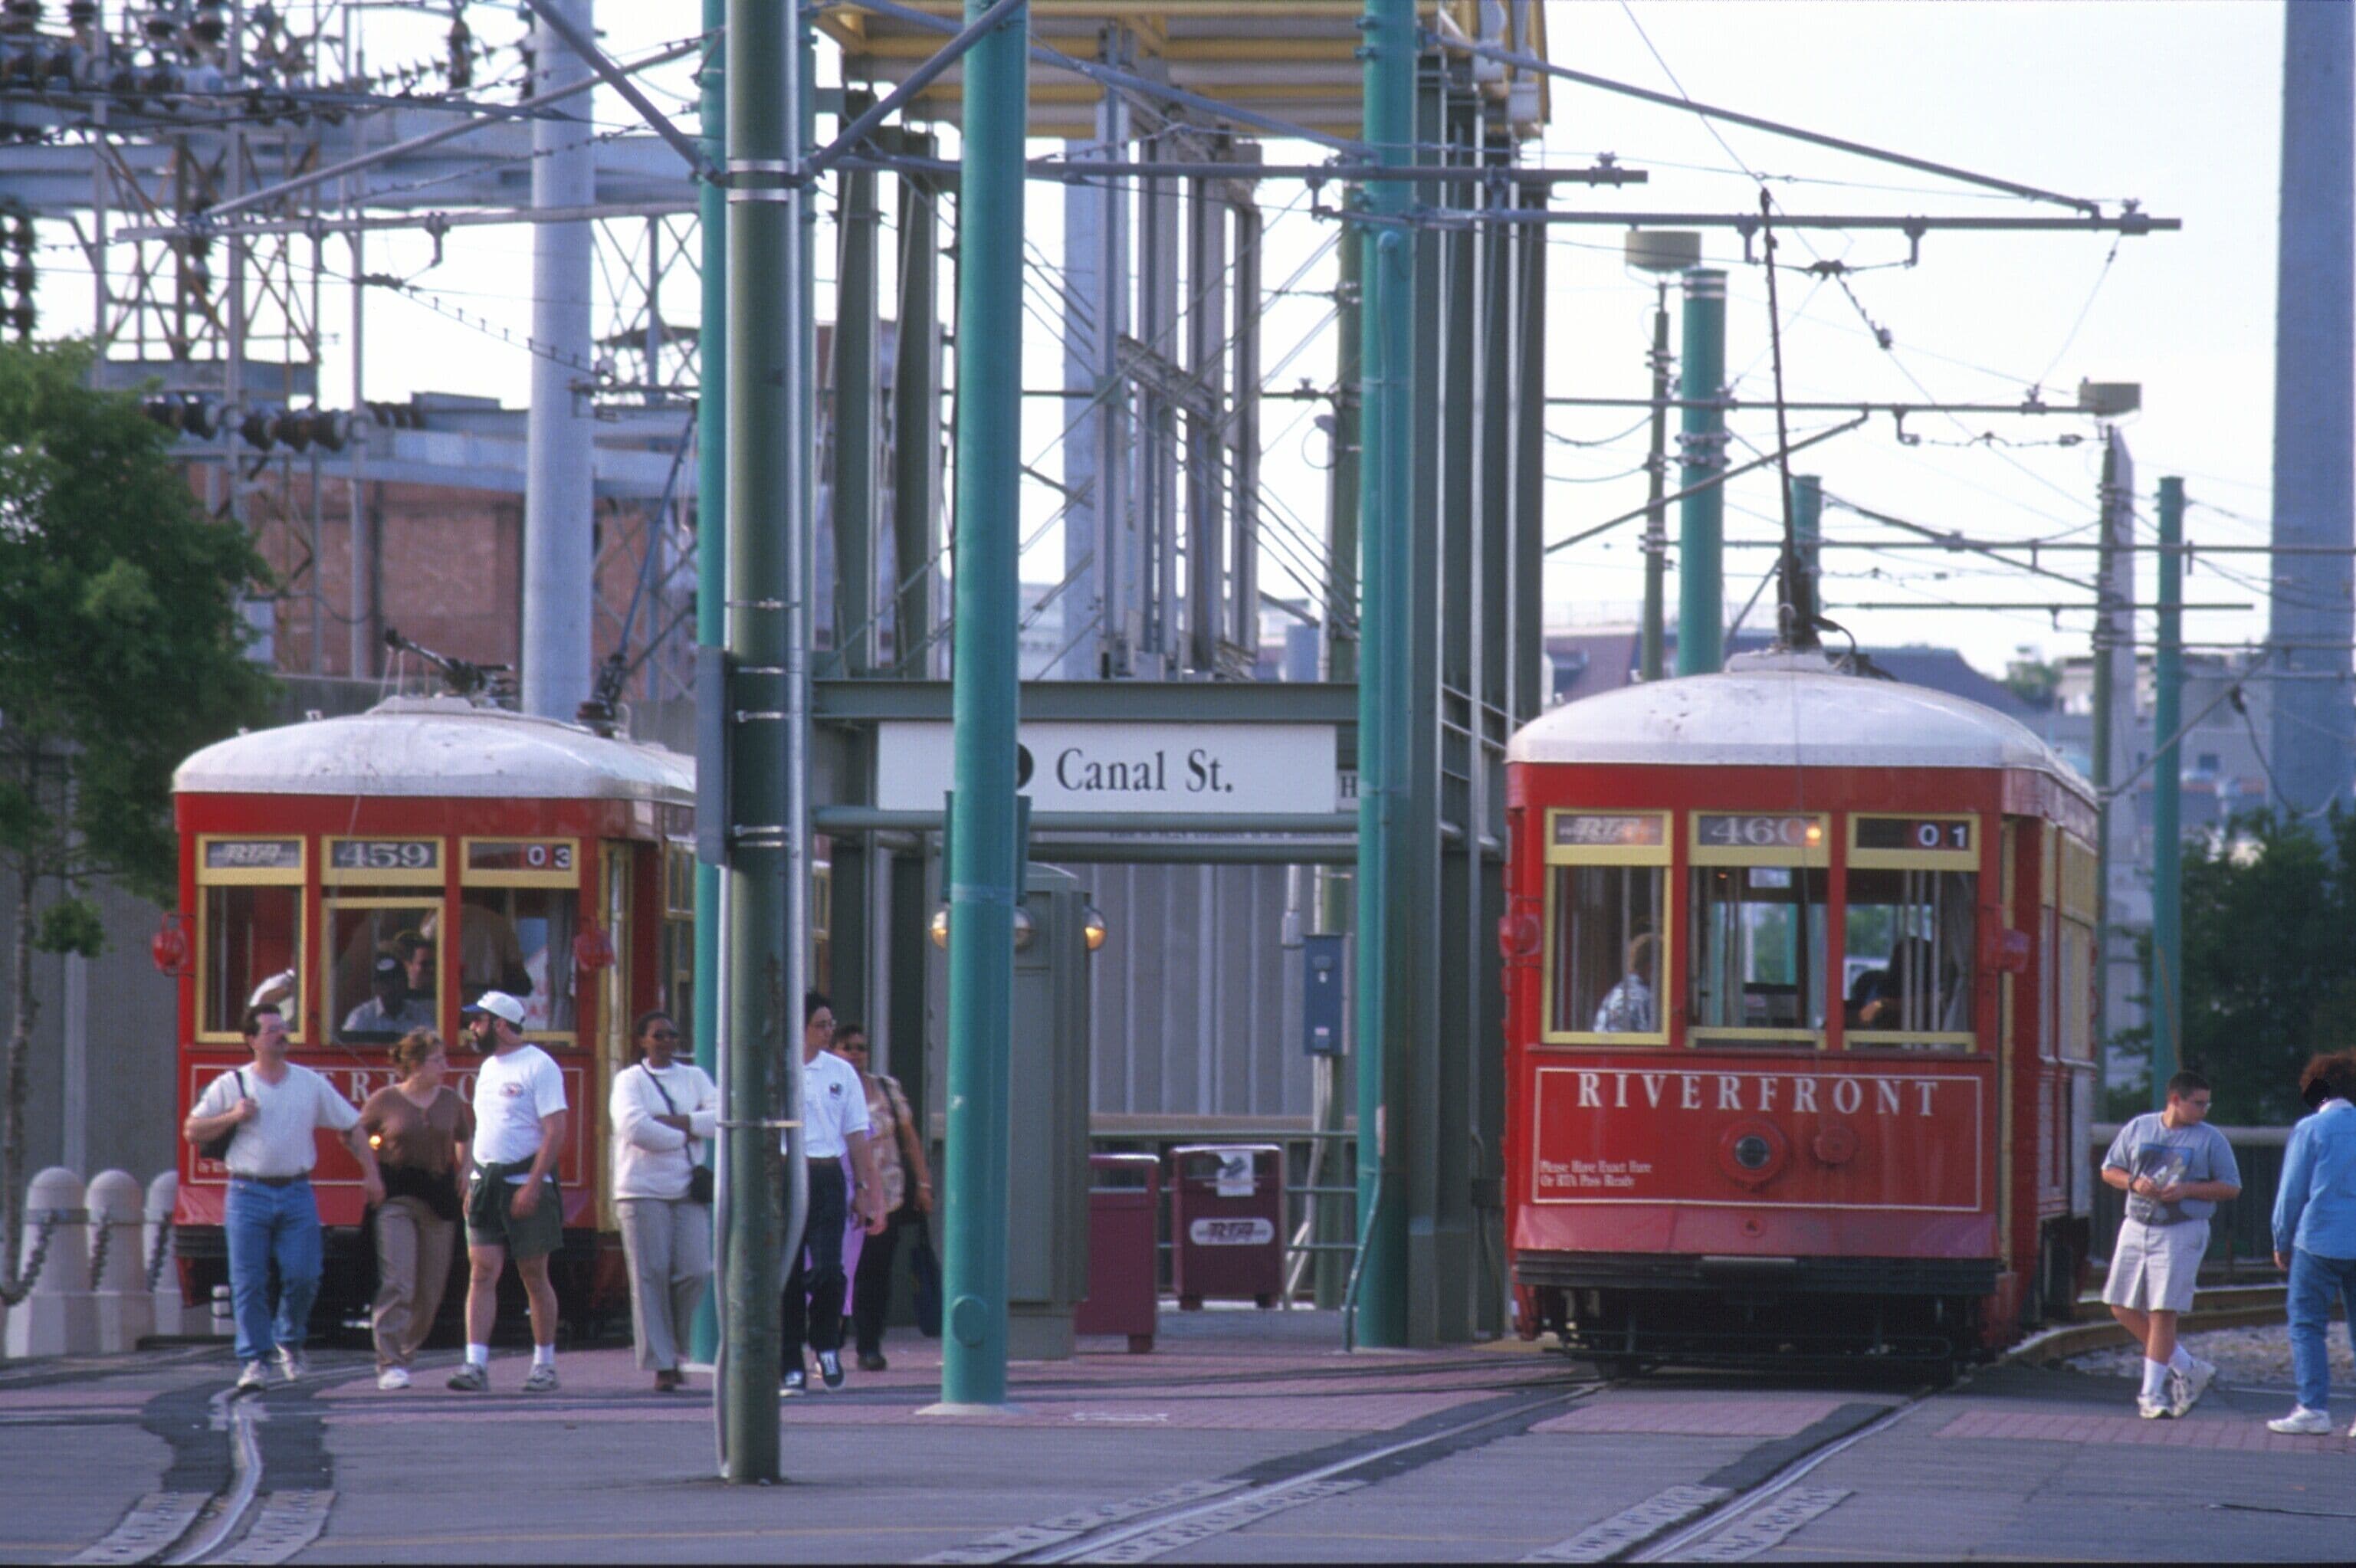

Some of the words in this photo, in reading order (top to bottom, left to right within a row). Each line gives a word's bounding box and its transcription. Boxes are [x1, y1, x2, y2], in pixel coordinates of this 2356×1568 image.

[1056, 747, 1167, 792] Canal
[1186, 749, 1234, 793] St.
[339, 843, 431, 868] 459
[1577, 1072, 1939, 1117] RIVERFRONT
